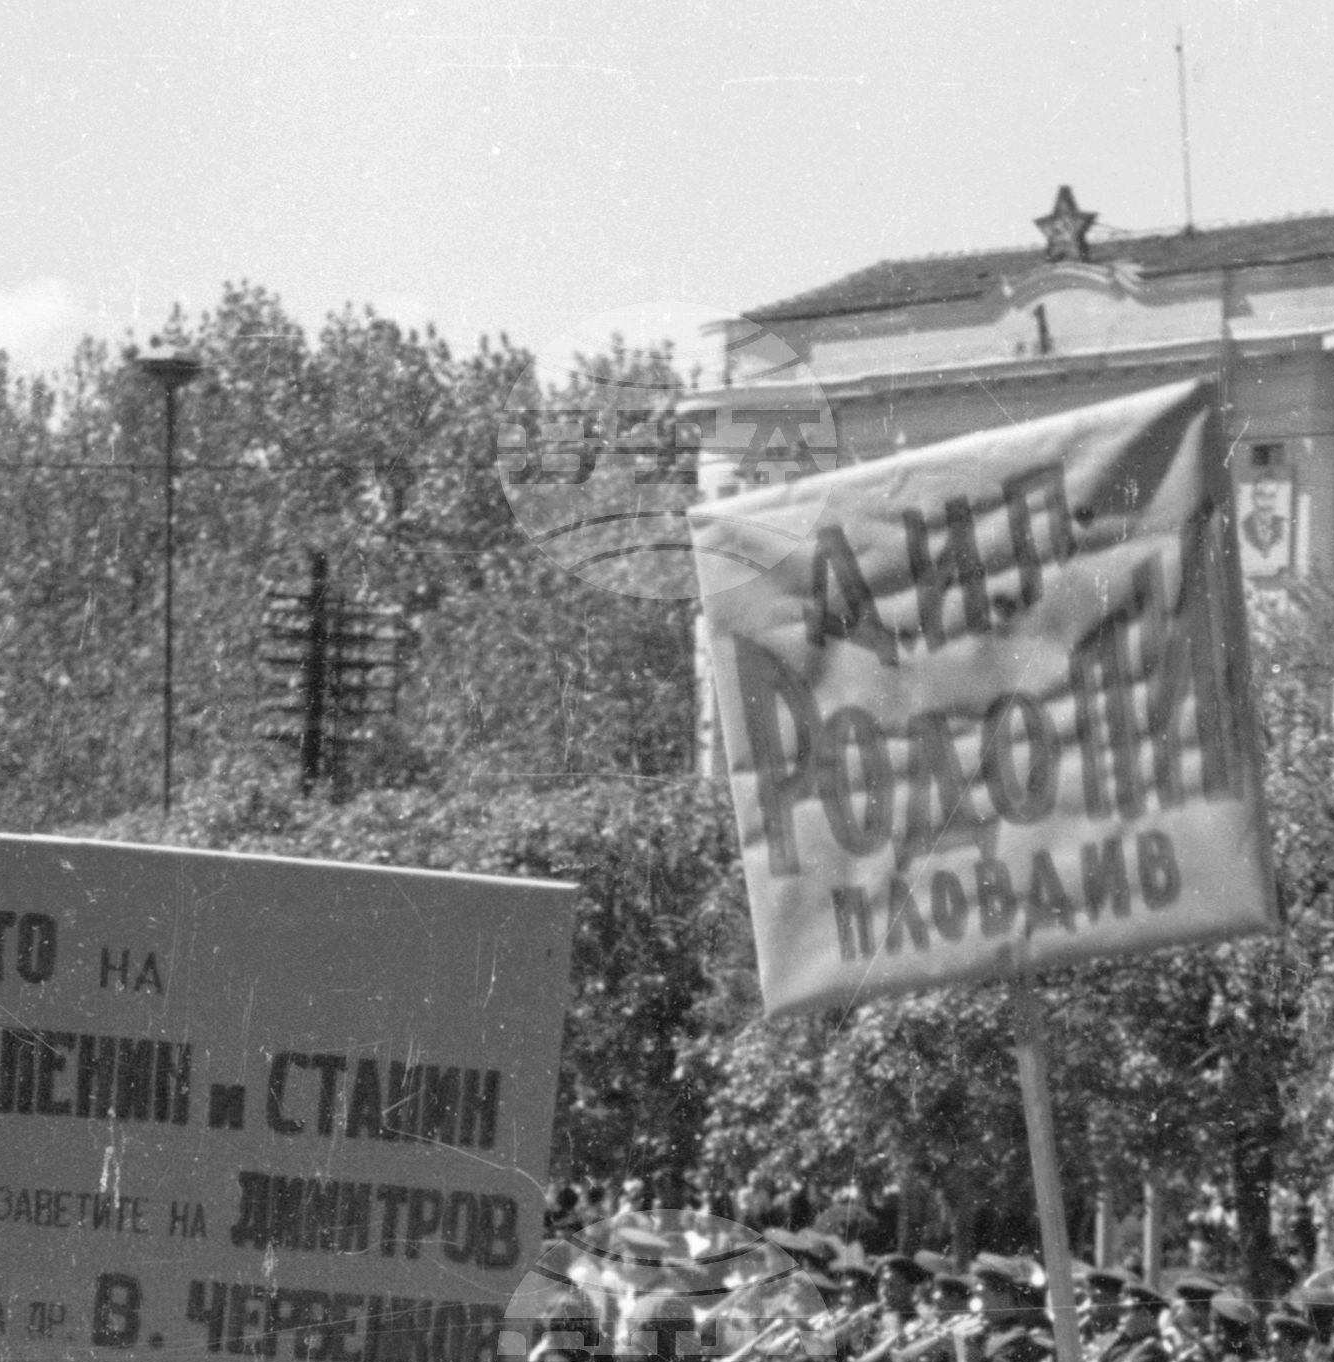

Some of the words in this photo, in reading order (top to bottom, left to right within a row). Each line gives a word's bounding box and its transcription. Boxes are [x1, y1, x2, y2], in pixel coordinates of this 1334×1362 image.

[731, 510, 1242, 876] РОДОПИ
[830, 829, 1183, 963] ПЛОВДИВ
[100, 946, 165, 996] НА
[268, 1050, 502, 1151] СТАЛИН
[169, 1200, 208, 1239] НА
[230, 1170, 521, 1271] ДИМИТРОВ
[91, 1272, 164, 1348] В.
